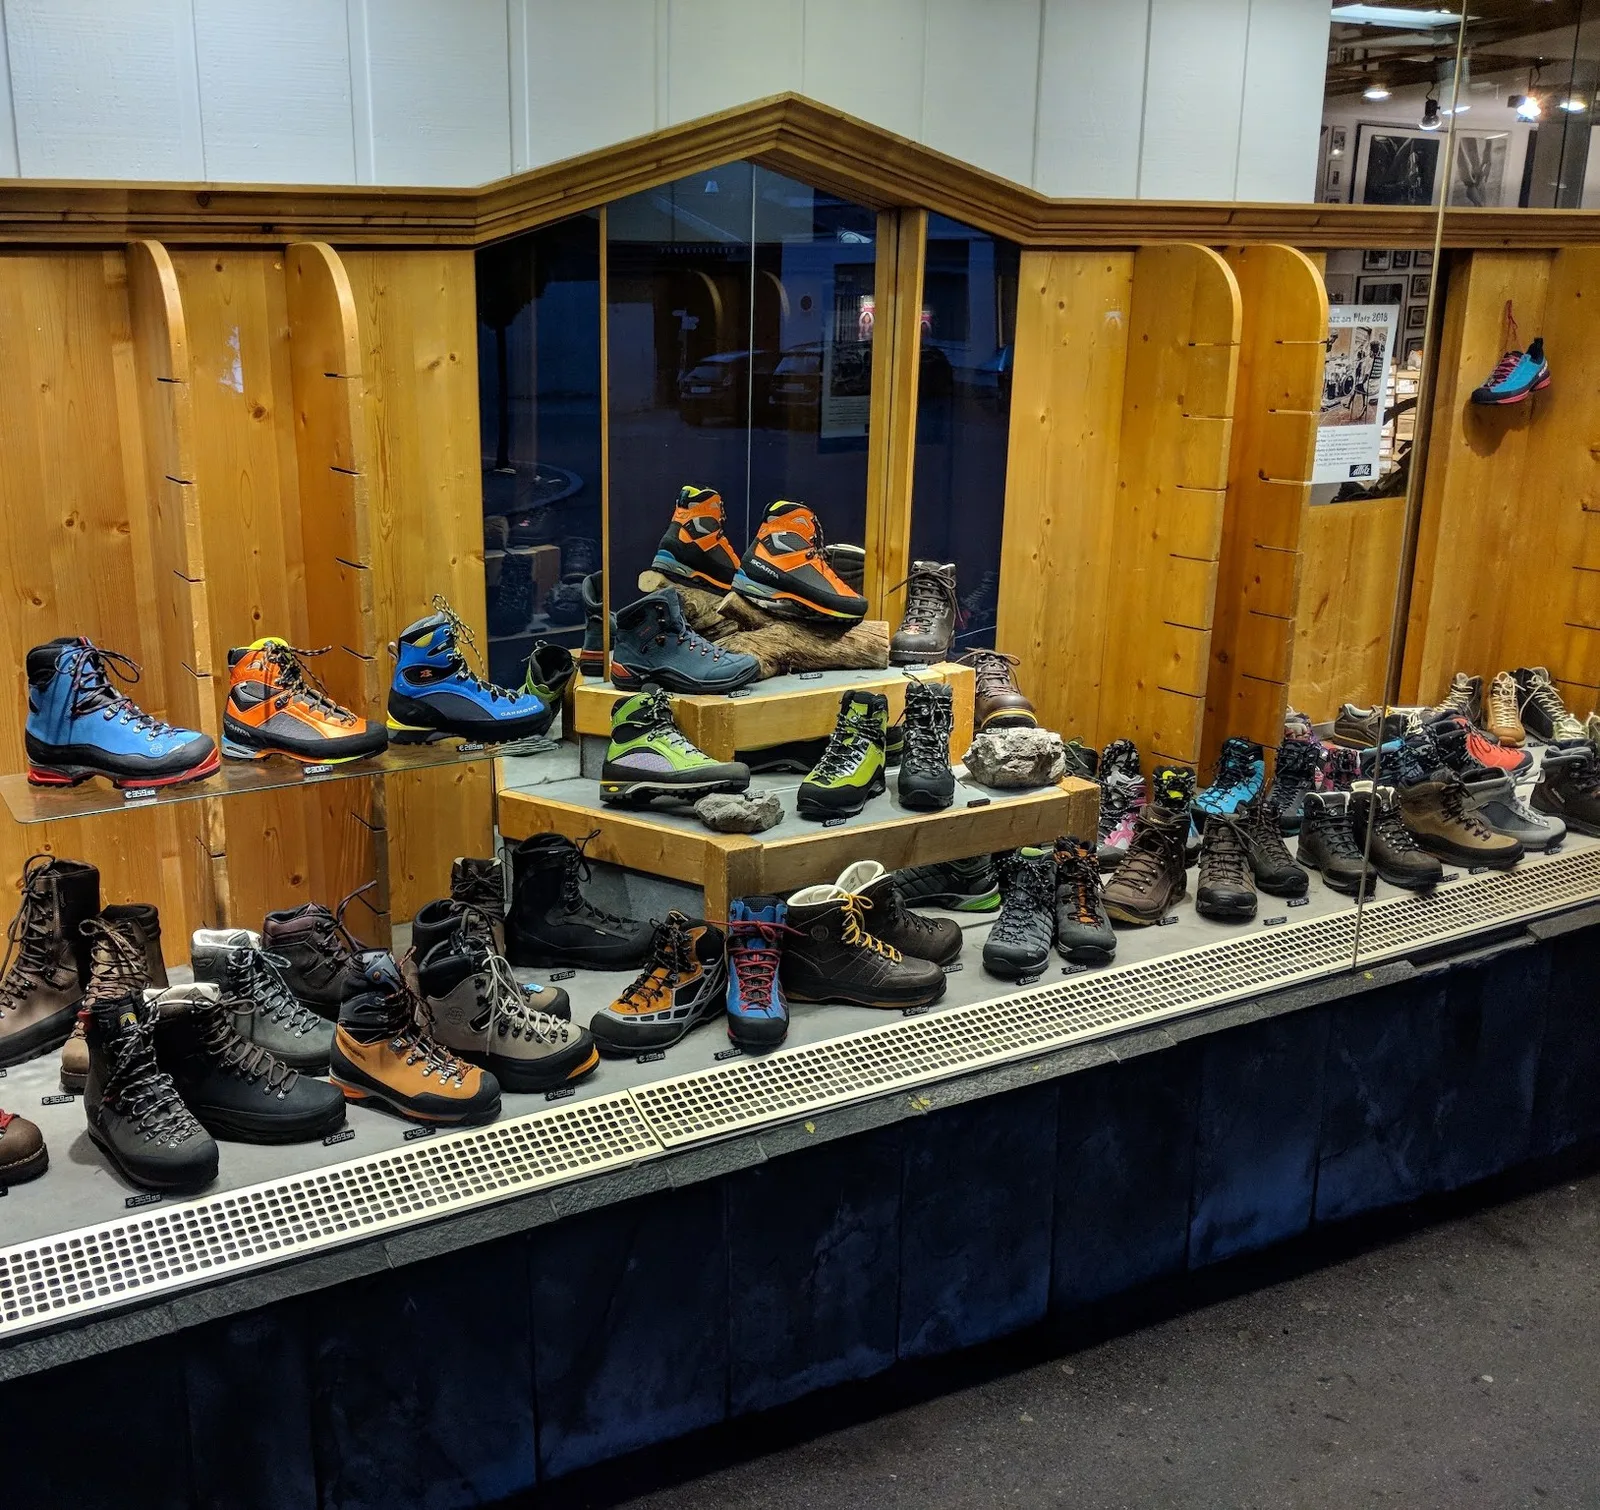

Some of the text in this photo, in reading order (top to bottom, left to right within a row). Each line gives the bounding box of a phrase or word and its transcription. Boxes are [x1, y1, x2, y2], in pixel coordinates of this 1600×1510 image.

[1353, 312, 1371, 323] Platz
[1372, 312, 1389, 322] 2018
[750, 558, 780, 580] SCARPA
[500, 705, 538, 717] GARMONT
